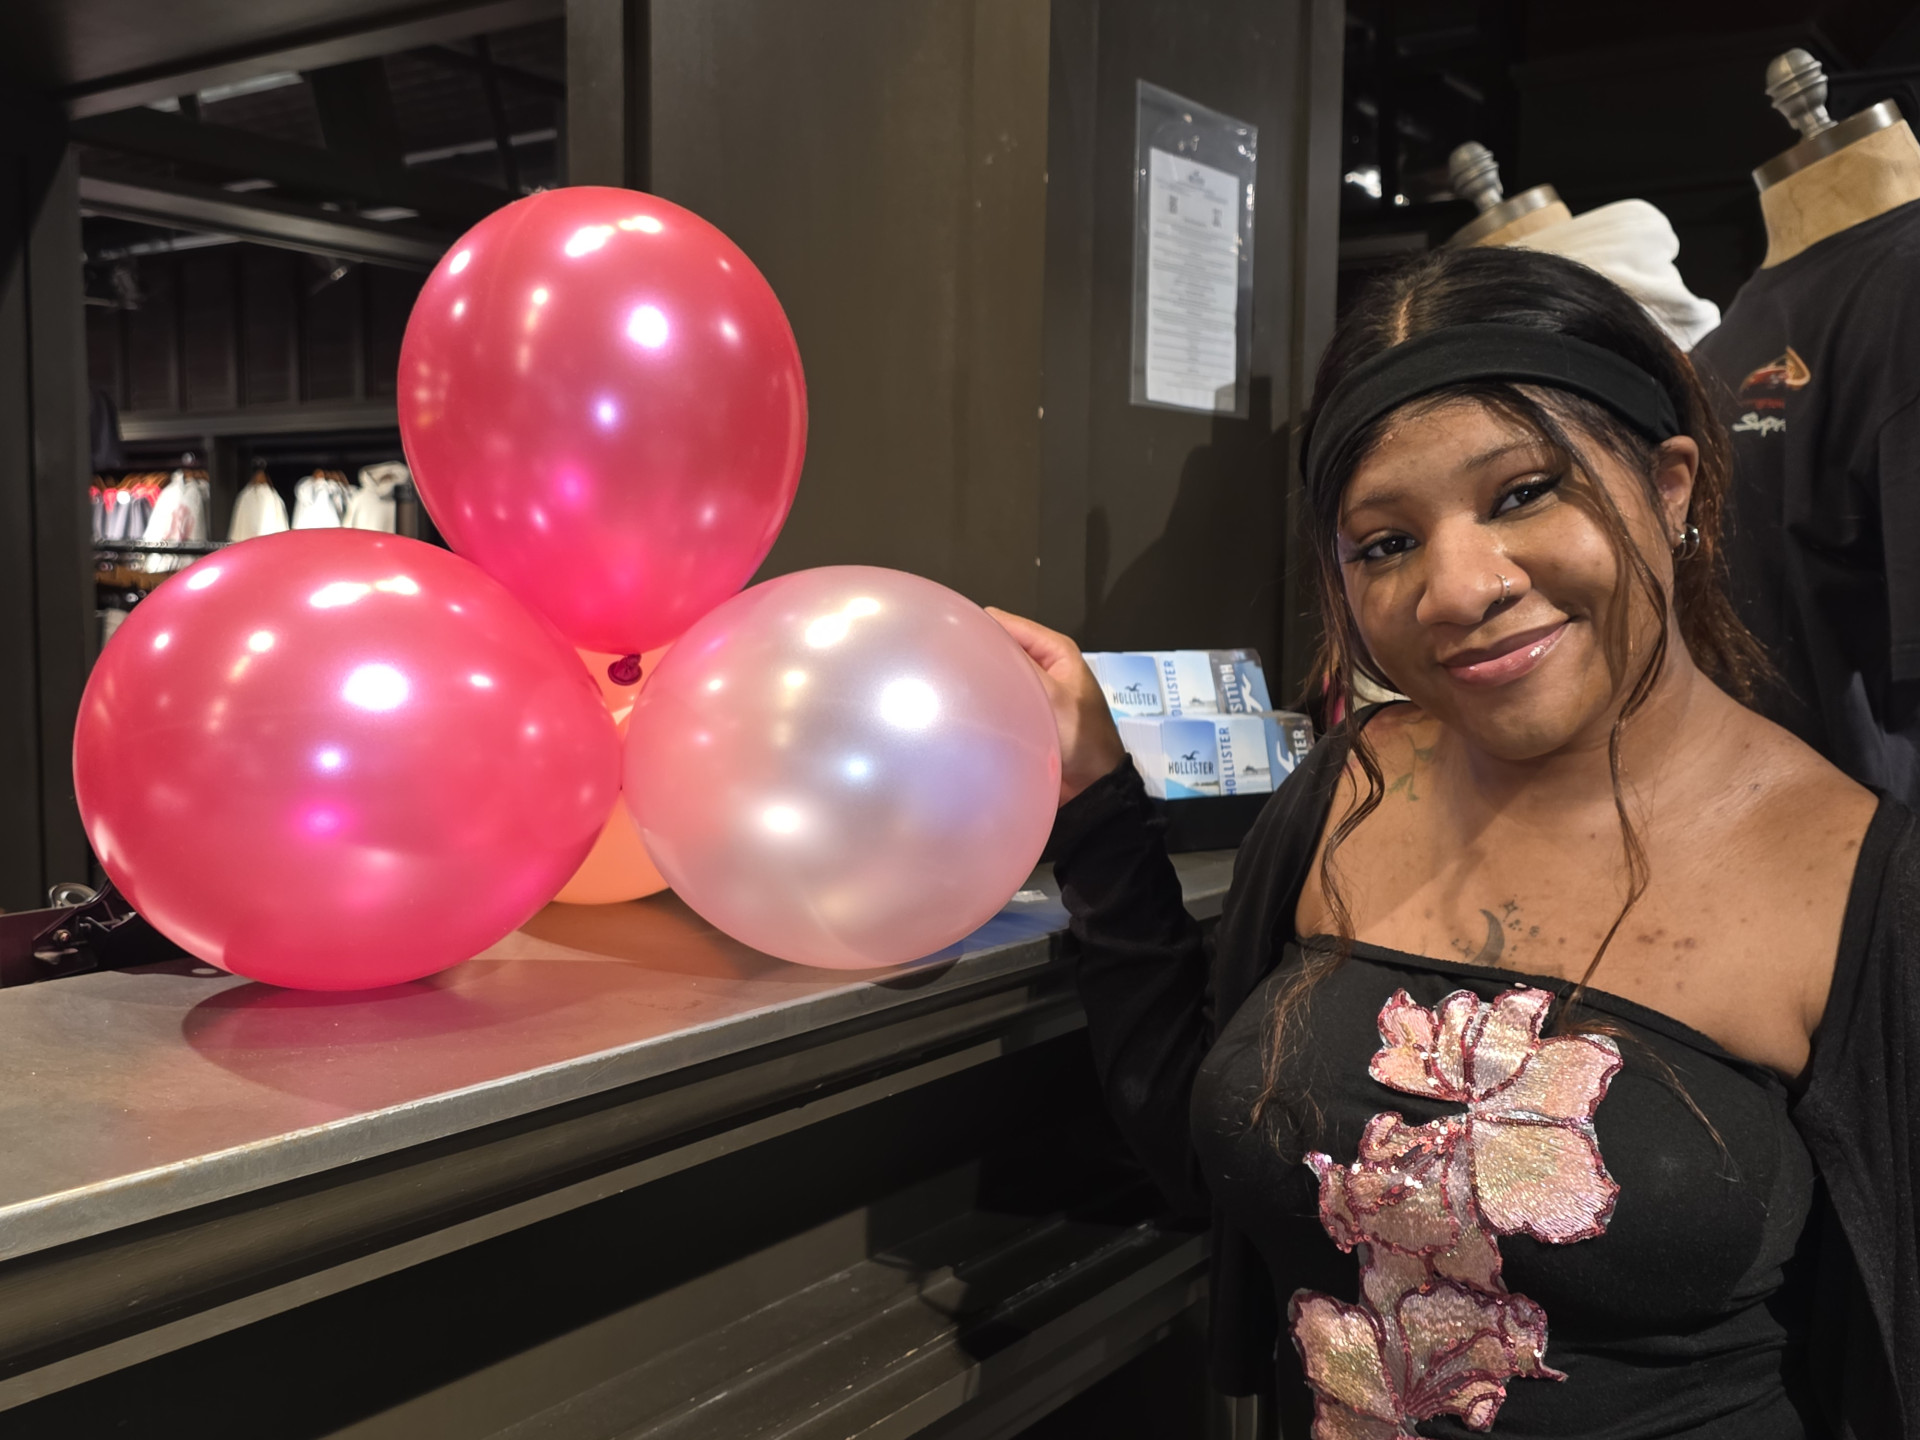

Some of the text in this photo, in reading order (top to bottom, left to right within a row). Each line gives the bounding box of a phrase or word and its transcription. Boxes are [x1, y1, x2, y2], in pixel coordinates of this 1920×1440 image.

[1112, 691, 1157, 705] HOLLISTER
[1164, 660, 1183, 716] OLLISTER
[1219, 664, 1243, 713] HOLLIS
[1168, 761, 1214, 775] HOLLISTER
[1219, 727, 1237, 796] HOLLISTER
